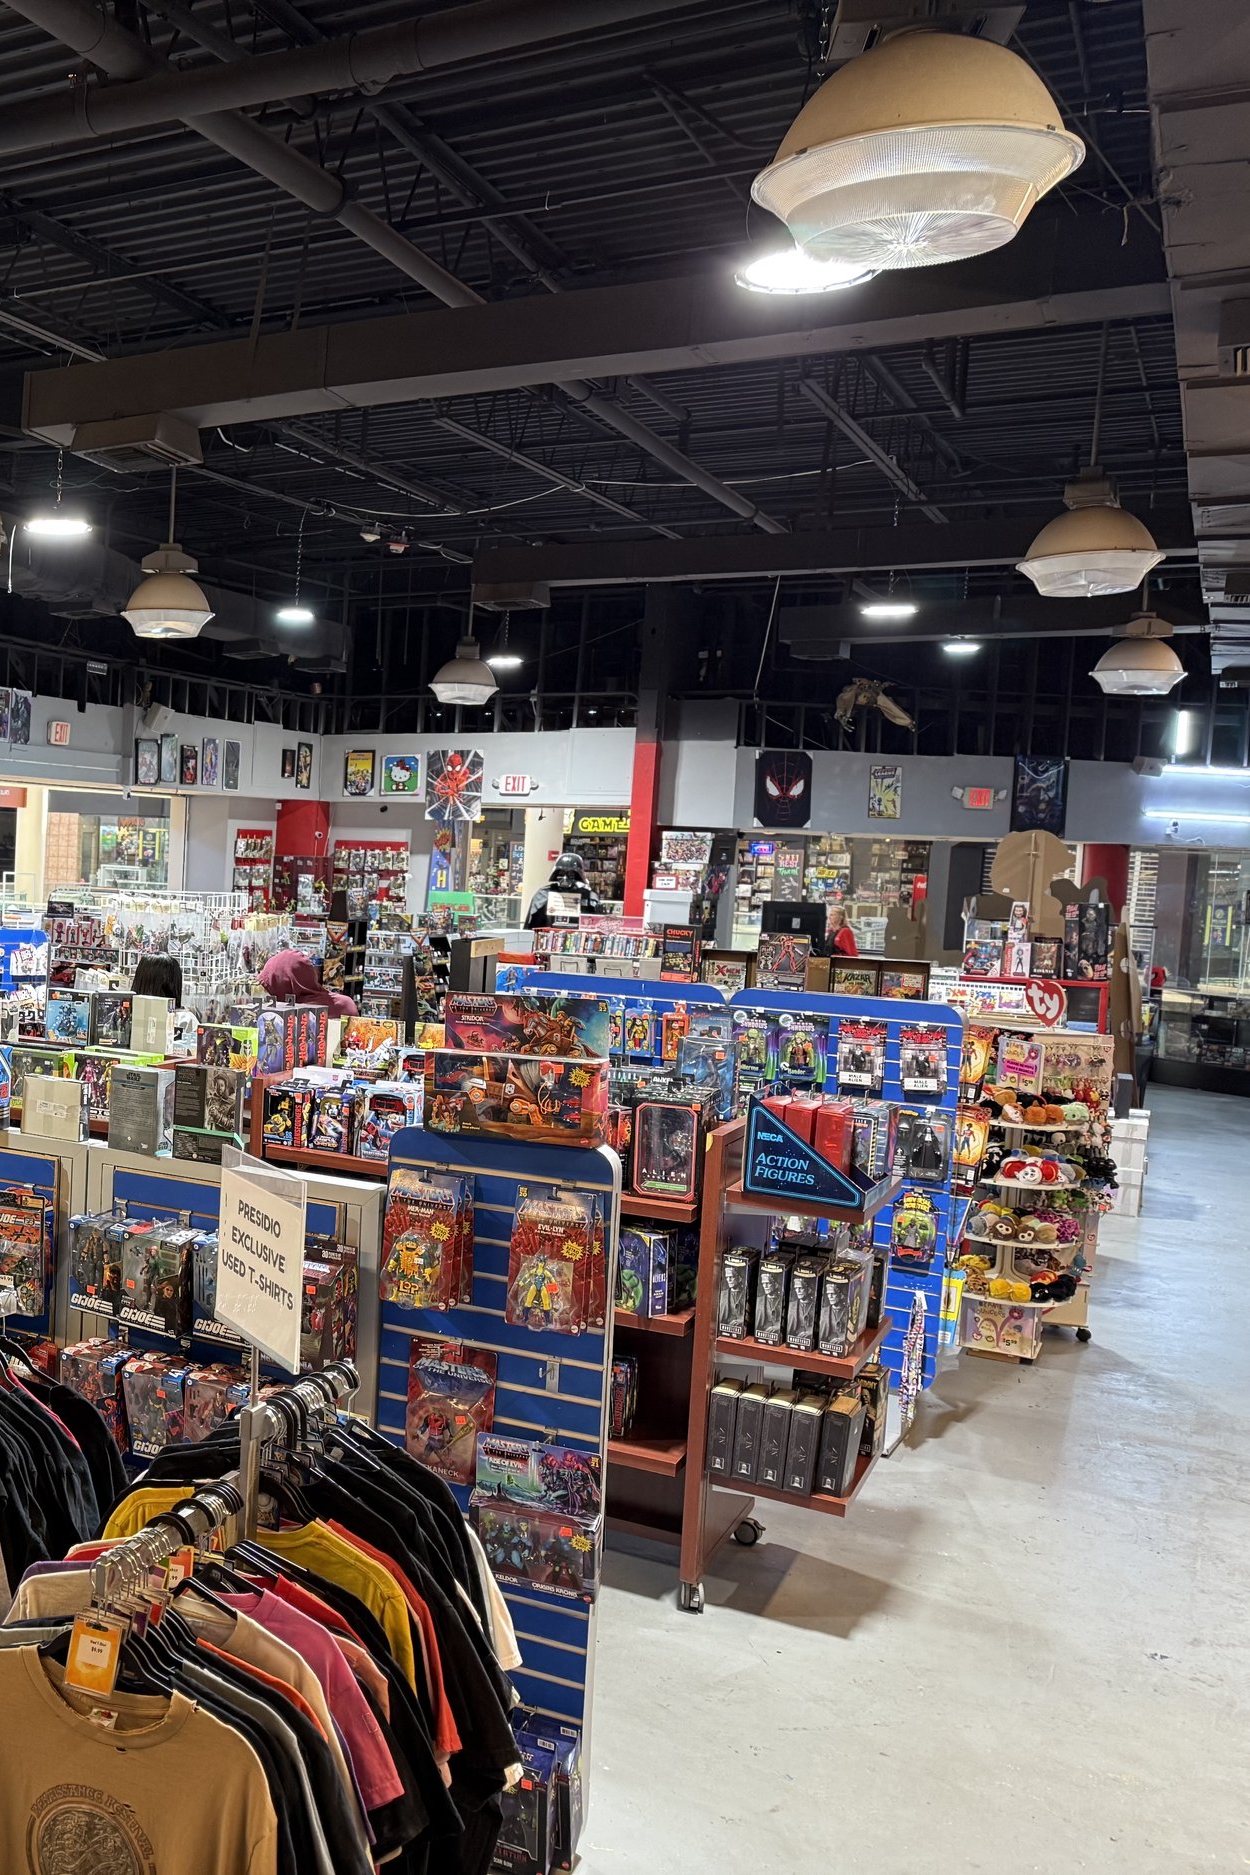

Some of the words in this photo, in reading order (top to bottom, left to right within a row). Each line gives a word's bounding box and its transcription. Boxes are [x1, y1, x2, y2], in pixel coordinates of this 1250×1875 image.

[55, 723, 69, 744] EXIT
[505, 775, 527, 793] EXIT
[970, 787, 990, 807] EXIT
[666, 928, 695, 937] CHUCKY
[715, 964, 741, 977] X-MEN
[450, 994, 496, 1008] MASTERS
[1027, 983, 1061, 1020] ty
[286, 1014, 294, 1062] HOWLING
[299, 1014, 308, 1060] HOWLING
[318, 1012, 326, 1059] HOWLING
[294, 1104, 302, 1147] TRANSFORMERS
[757, 1131, 784, 1144] NECA
[755, 1153, 810, 1171] ACTION
[754, 1165, 815, 1186] FIGURES
[392, 1184, 454, 1205] MASTERS
[237, 1199, 282, 1239] PRESIDIO
[231, 1225, 286, 1274] EXCLUSIVE
[322, 1250, 329, 1259] 30
[336, 1245, 344, 1253] 30
[222, 1248, 247, 1279] USED
[247, 1265, 294, 1311] T-SHIRTS
[414, 1356, 489, 1379] MASTERS
[428, 1367, 447, 1376] THE
[448, 1371, 495, 1385] UNIVERSE
[484, 1437, 529, 1457] MASTERS
[510, 1461, 523, 1469] EVIL
[495, 1574, 519, 1583] KELDOR
[31, 1783, 104, 1819] RENAISSANCE
